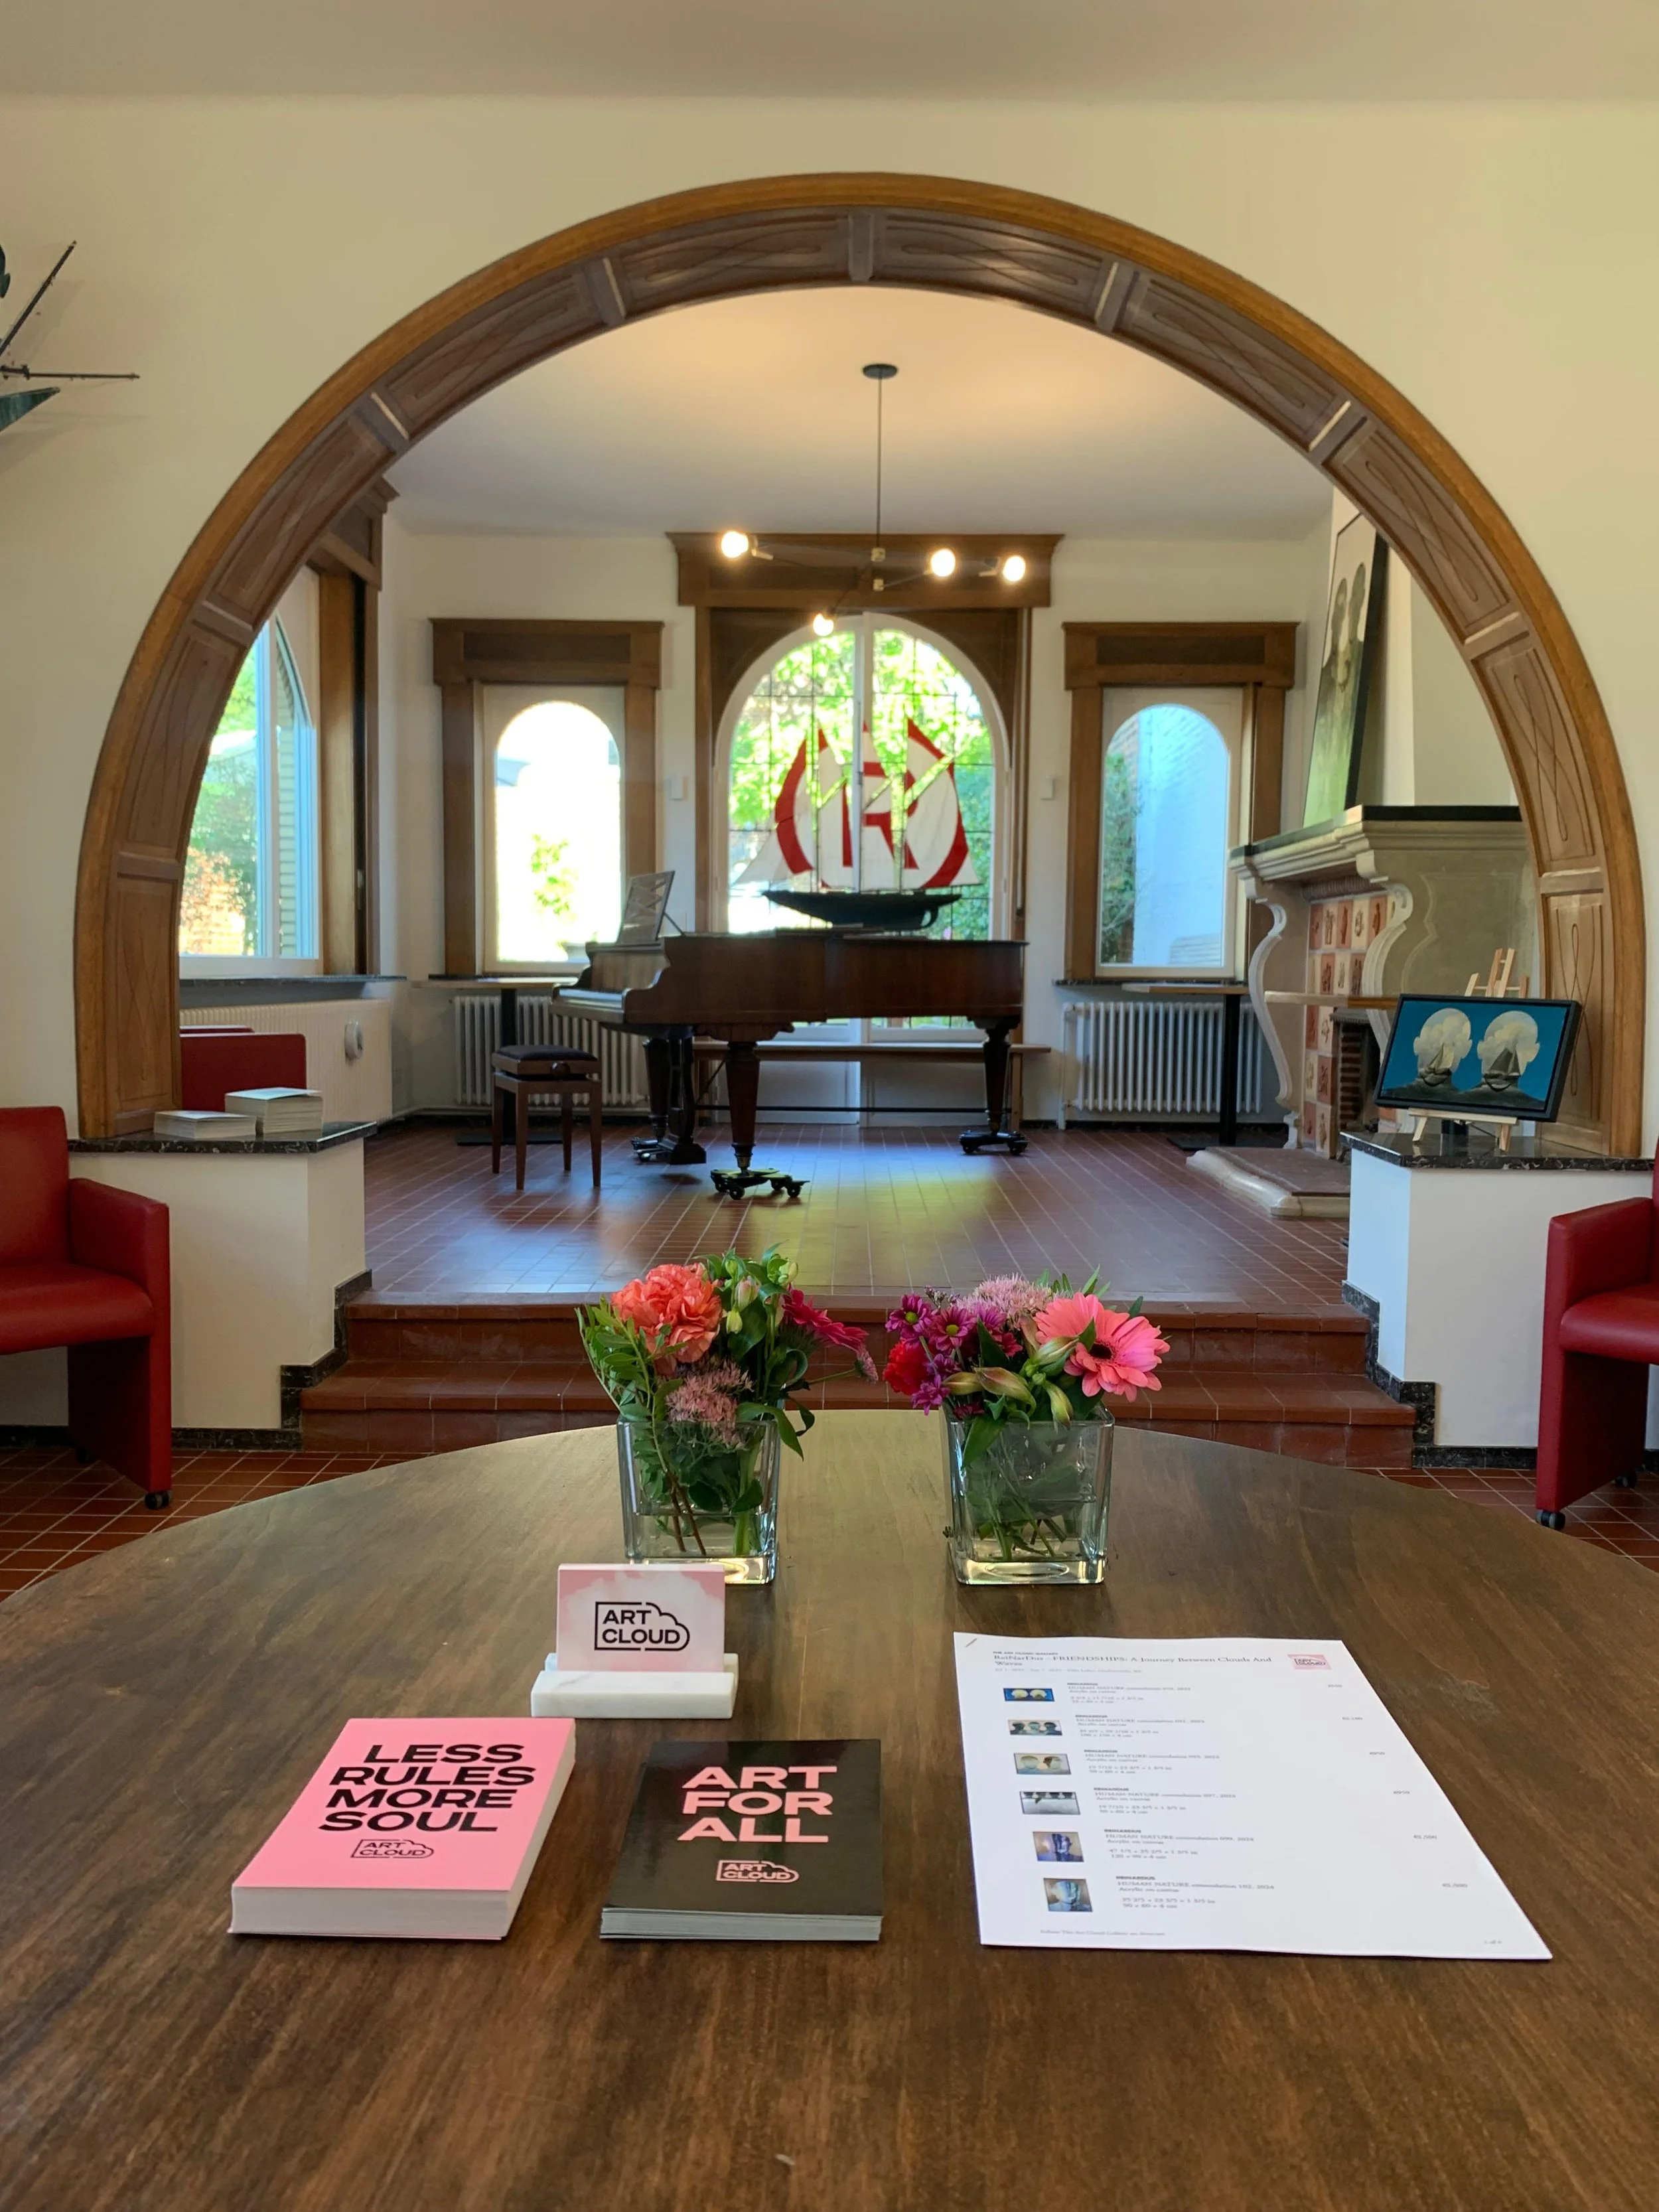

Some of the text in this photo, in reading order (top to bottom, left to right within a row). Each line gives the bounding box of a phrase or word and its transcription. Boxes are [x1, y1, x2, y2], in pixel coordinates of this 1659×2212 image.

[603, 1609, 652, 1625] ART
[602, 1629, 680, 1644] CLOUD
[363, 1744, 525, 1763] LESS
[329, 1766, 536, 1786] RULES
[682, 1766, 837, 1789] ART
[325, 1788, 518, 1808] MORE
[682, 1791, 833, 1815] FOR
[319, 1811, 498, 1832] SOUL
[677, 1817, 829, 1843] ALL
[723, 1871, 792, 1880] CLOUD
